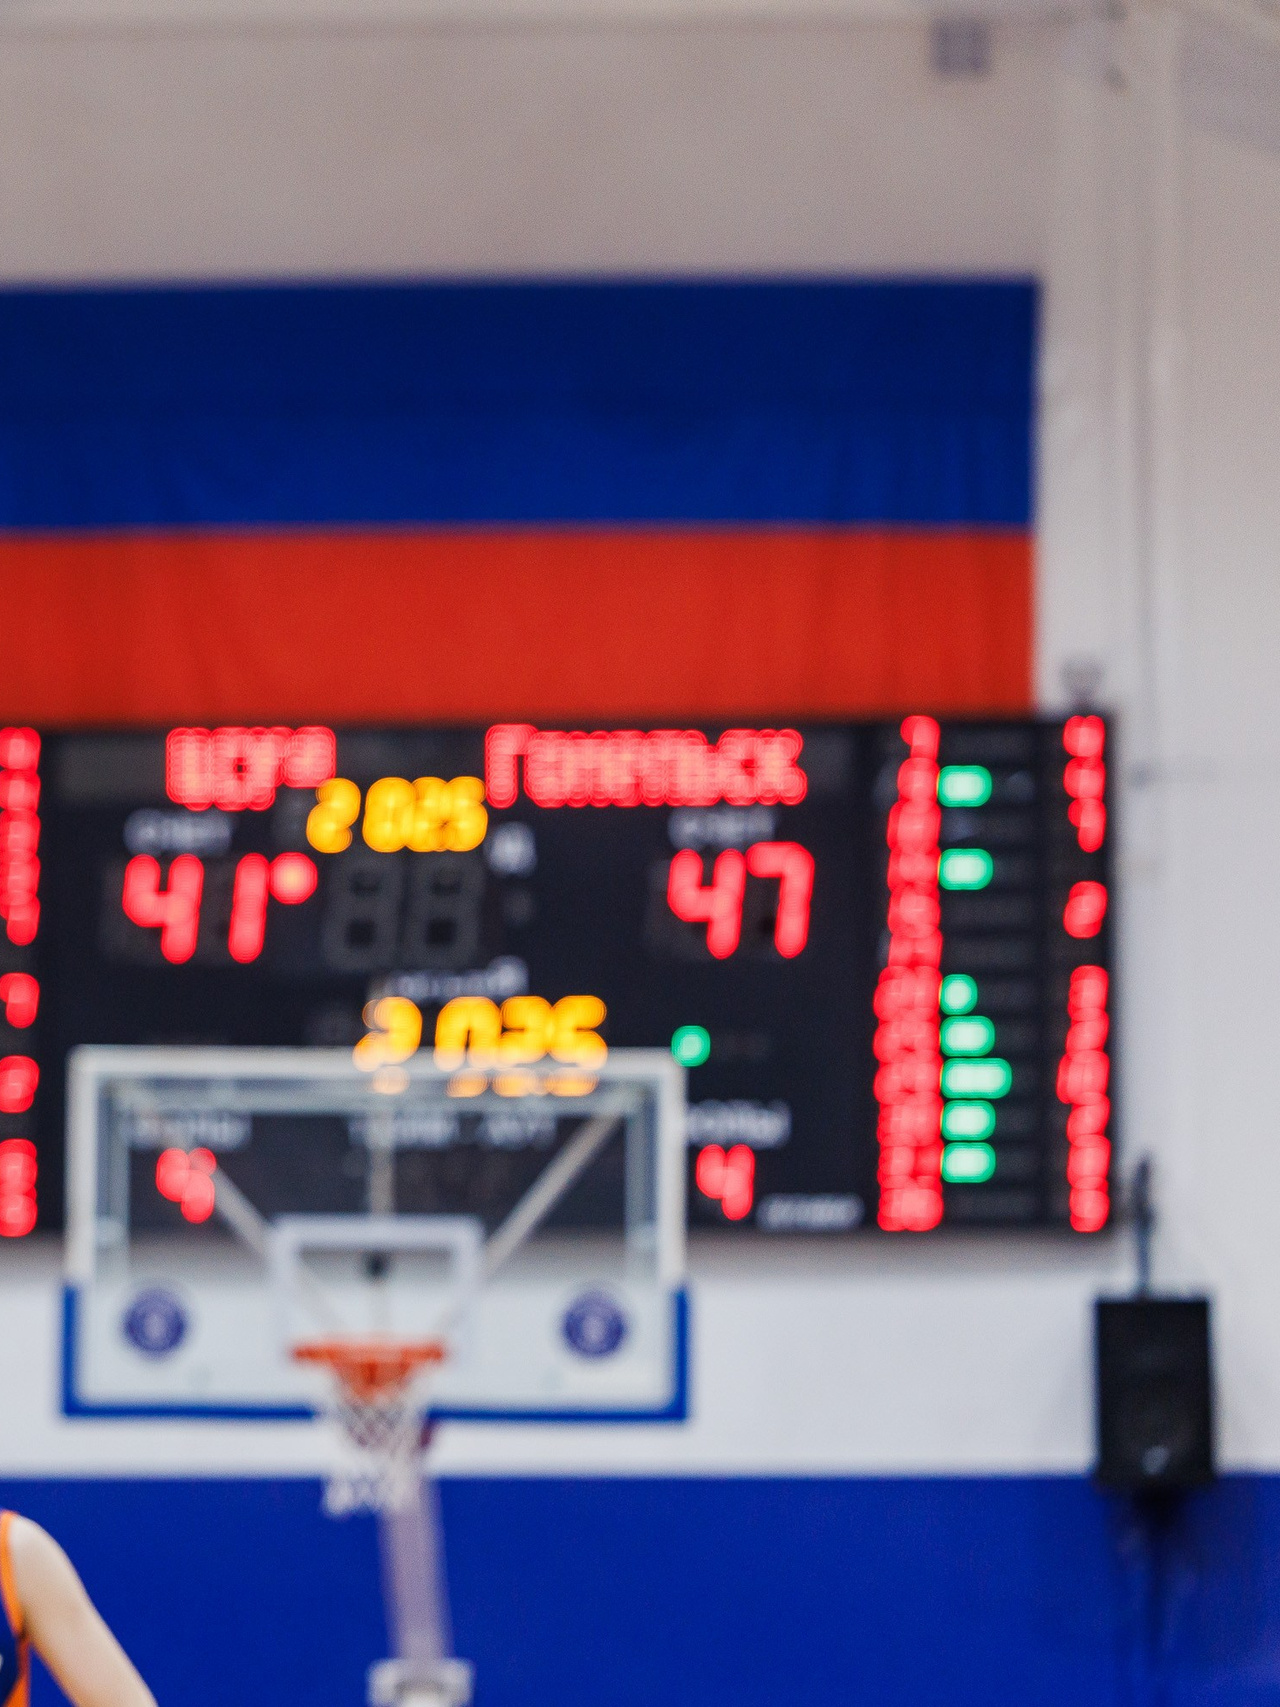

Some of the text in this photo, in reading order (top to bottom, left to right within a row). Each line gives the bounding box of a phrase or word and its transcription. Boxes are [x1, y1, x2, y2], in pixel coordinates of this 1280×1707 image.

[122, 852, 269, 964] 41
[667, 841, 815, 959] 47
[696, 1144, 755, 1221] 4
